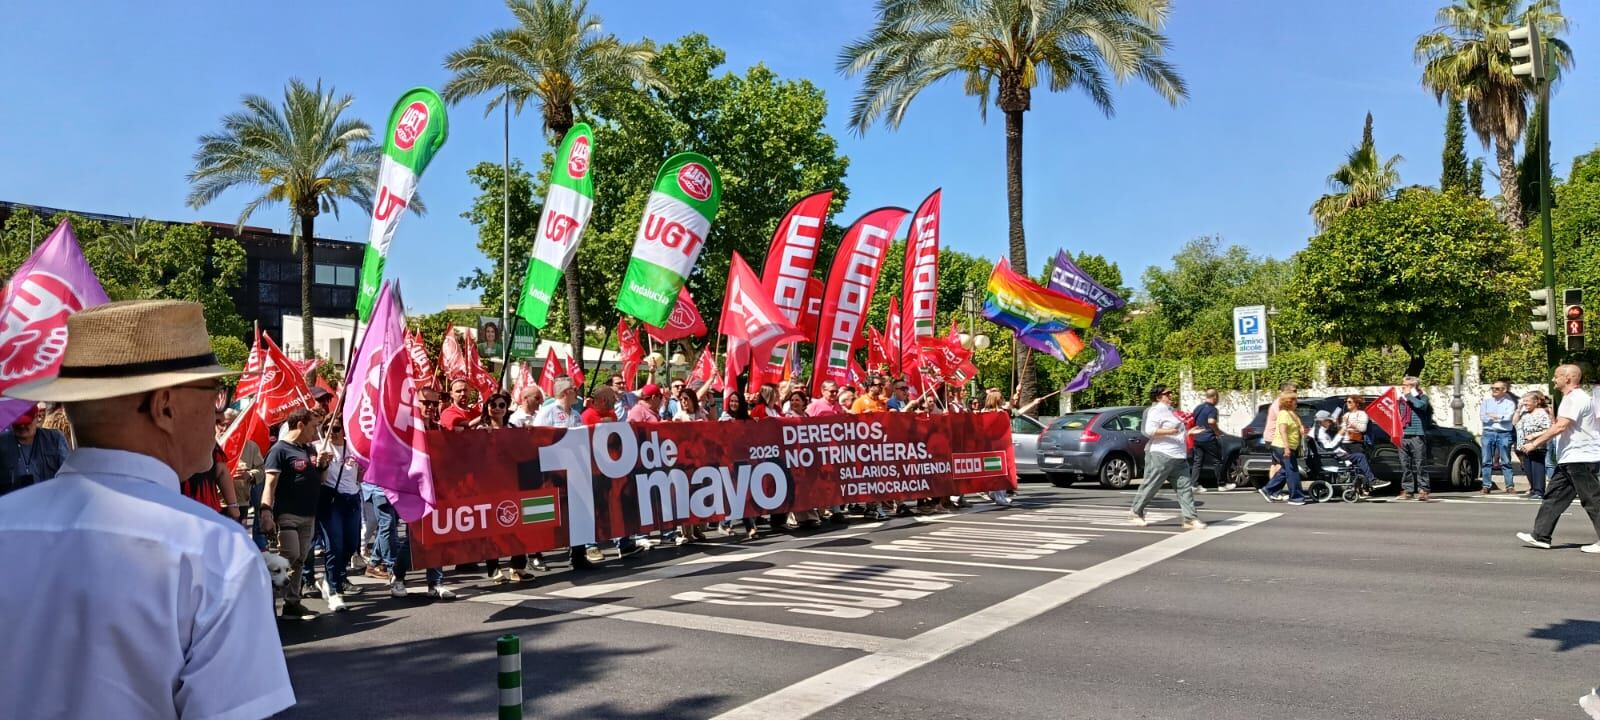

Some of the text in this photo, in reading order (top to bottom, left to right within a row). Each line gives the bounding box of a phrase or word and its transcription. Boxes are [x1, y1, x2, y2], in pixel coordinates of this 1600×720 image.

[545, 210, 581, 246] UGT
[644, 214, 703, 257] UGT
[832, 224, 888, 342] CCOO
[1242, 318, 1255, 334] P
[782, 421, 888, 445] DERECHOS,
[640, 431, 678, 469] de
[750, 445, 780, 460] 2026
[785, 442, 933, 469] NO TRINCHERAS.
[839, 461, 952, 480] SALARIOS, VIVIENDA
[954, 457, 982, 473] CCOO
[635, 461, 788, 526] mayo
[840, 479, 930, 498] Y DEMOCRACIA
[432, 503, 492, 535] UGT
[670, 561, 981, 619] MOTOS
